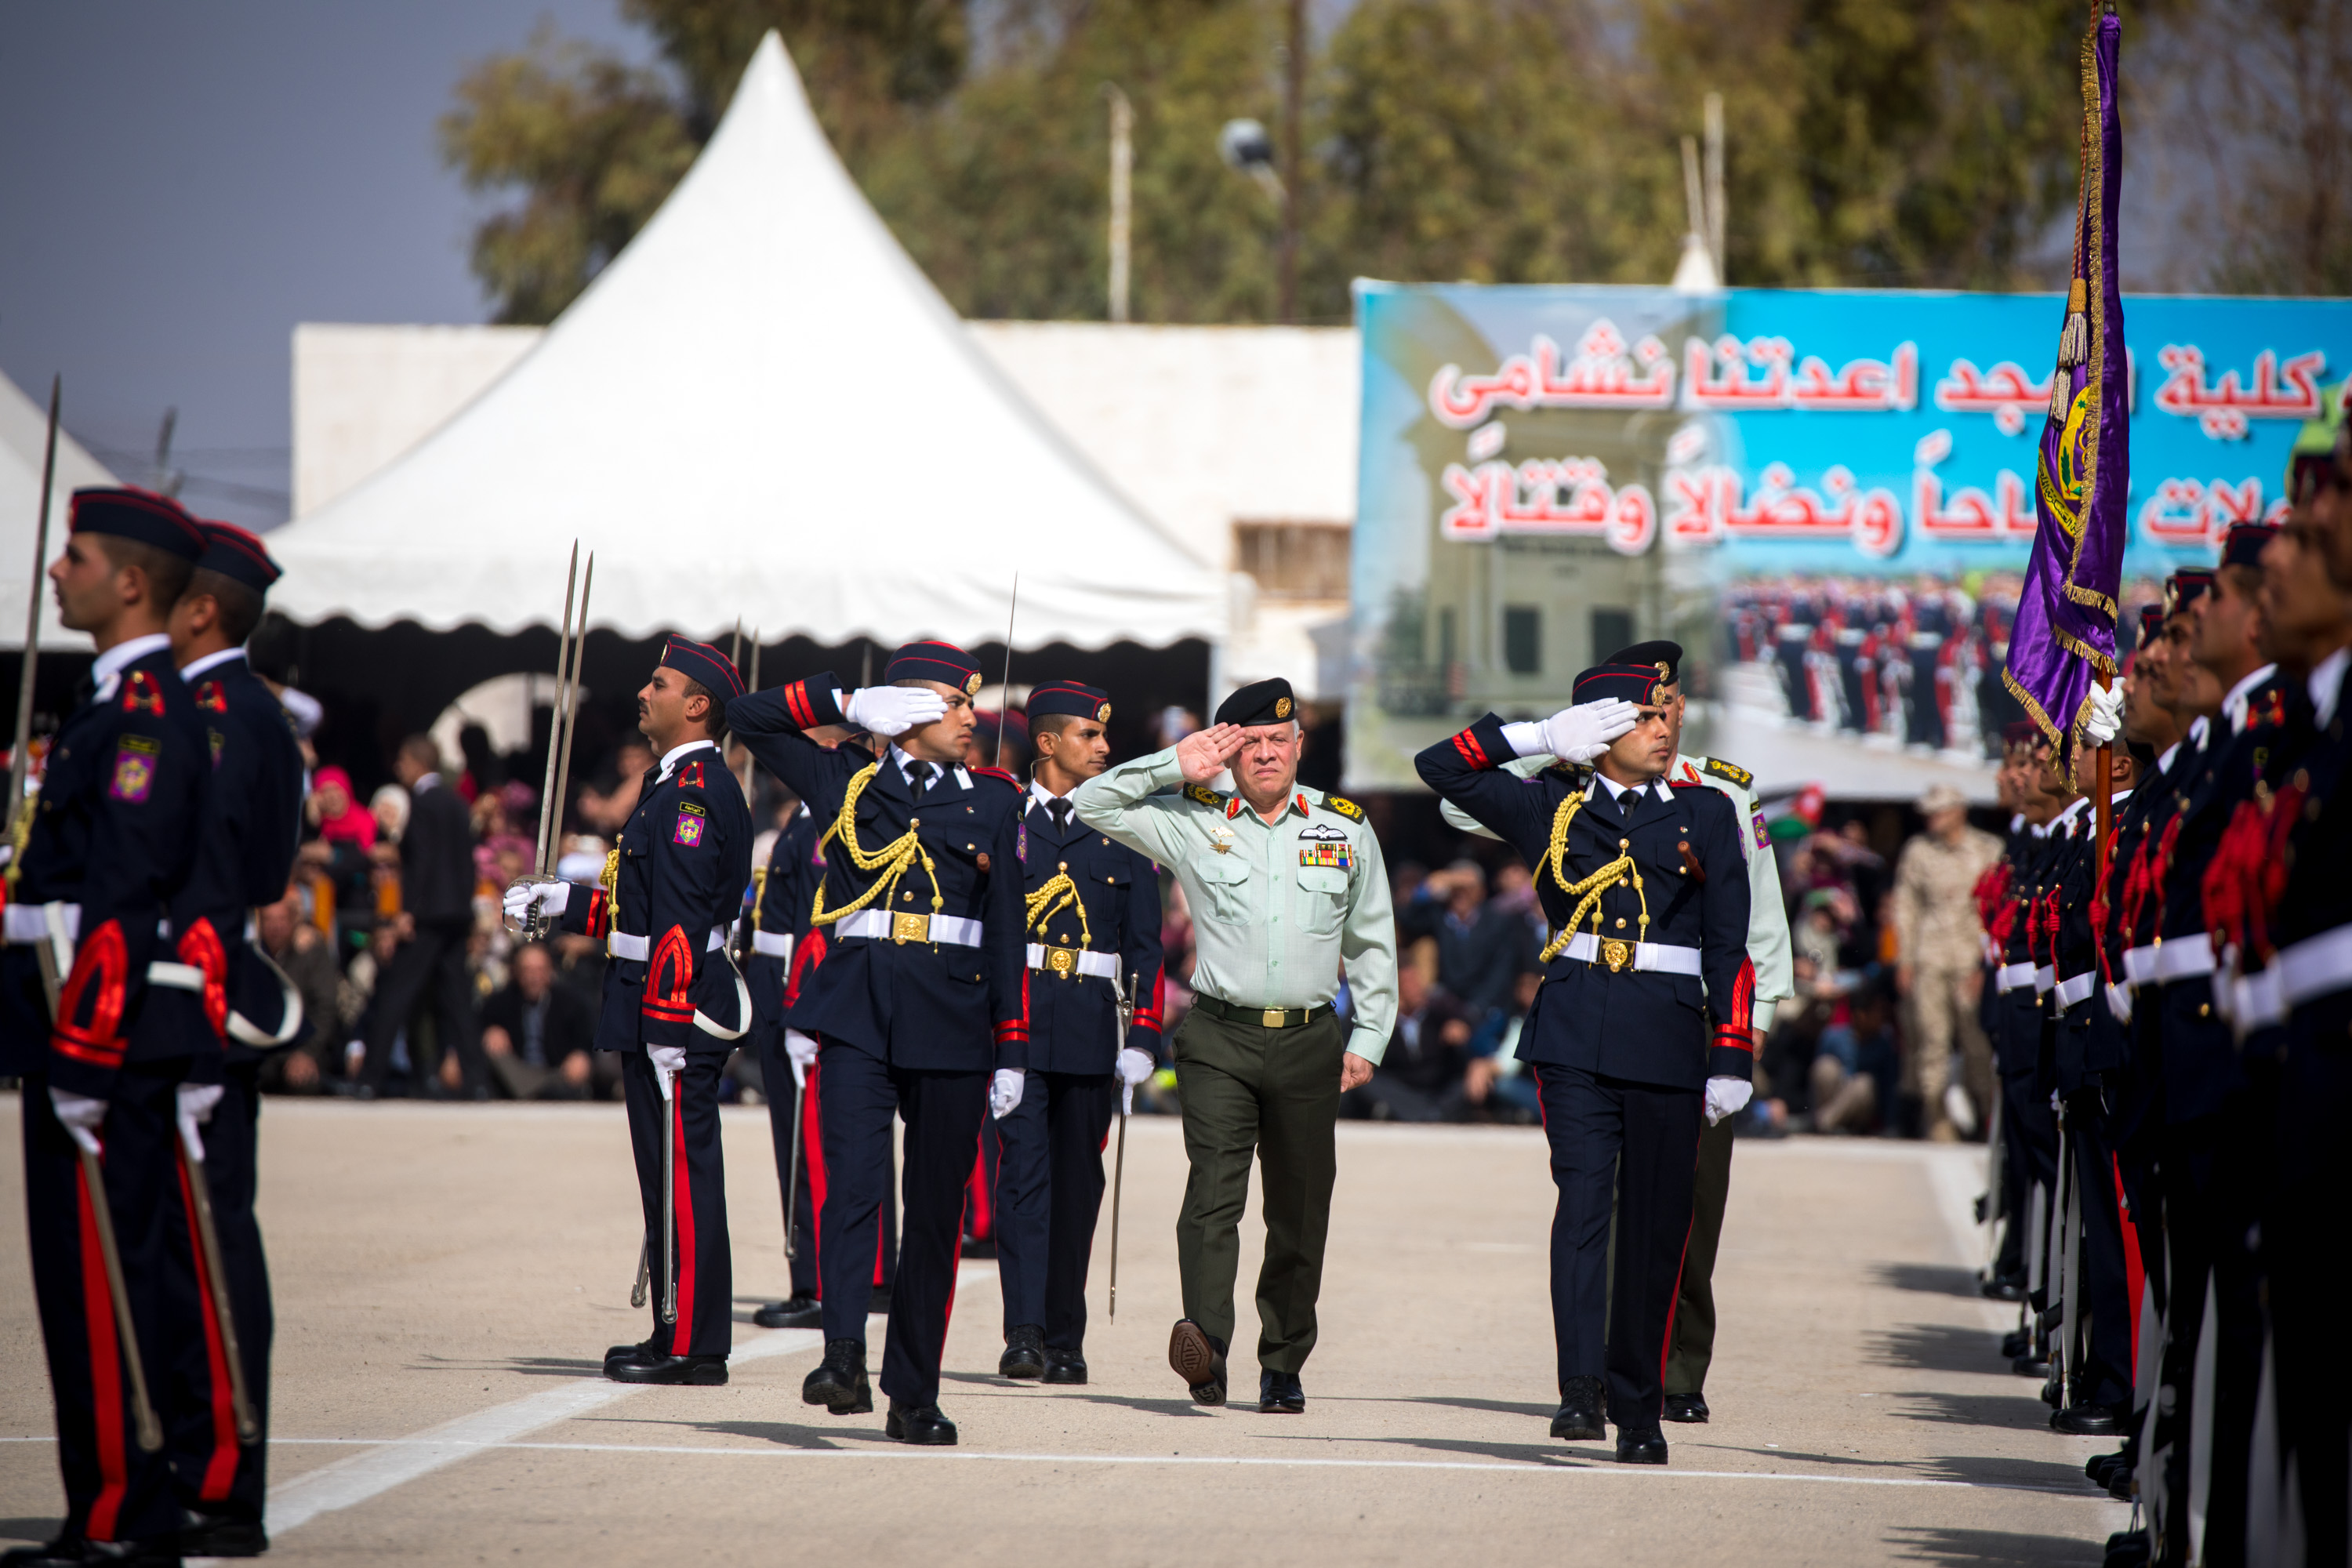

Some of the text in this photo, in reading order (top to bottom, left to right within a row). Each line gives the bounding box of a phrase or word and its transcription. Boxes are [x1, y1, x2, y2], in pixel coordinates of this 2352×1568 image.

[1429, 318, 1676, 430] نشامى
[1685, 334, 1918, 412] اعدتنا
[2155, 343, 2325, 439] كلية
